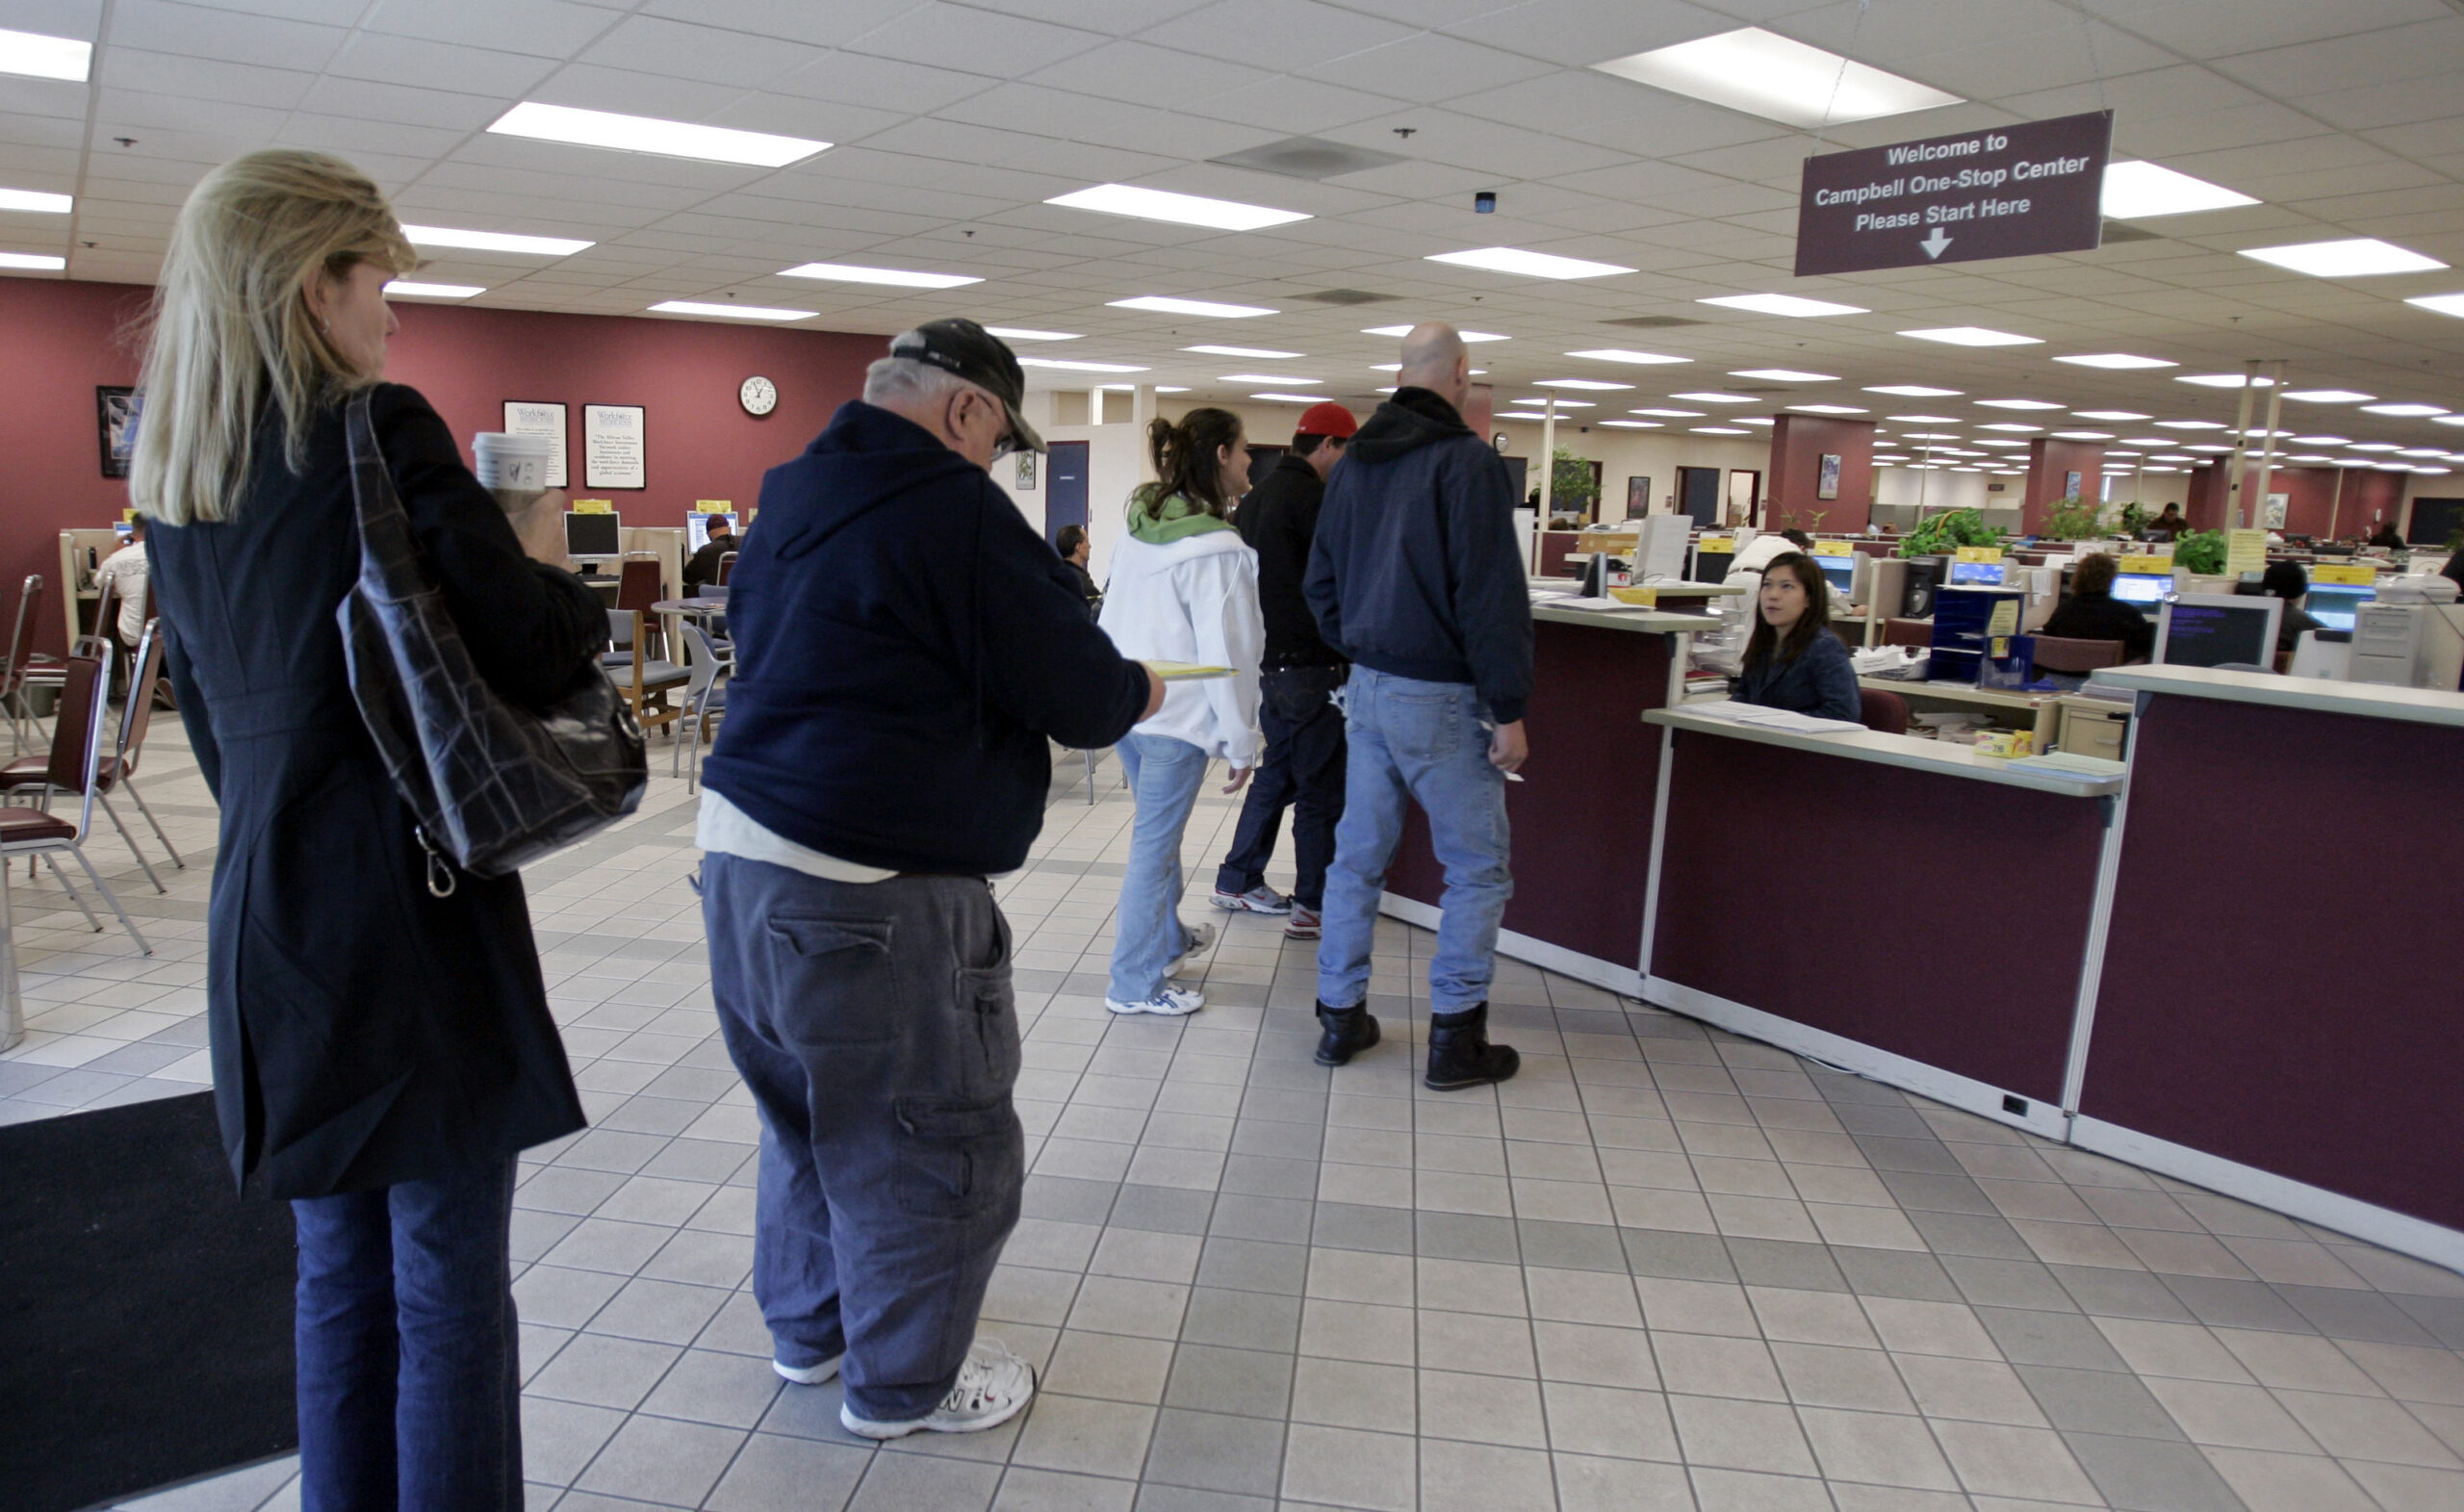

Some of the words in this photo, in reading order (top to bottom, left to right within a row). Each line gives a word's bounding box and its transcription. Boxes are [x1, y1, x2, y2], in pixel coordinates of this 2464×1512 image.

[1887, 141, 1981, 167] Welcome
[1985, 134, 2009, 153] to
[1815, 178, 1905, 207] Campbell
[1910, 167, 2008, 195] One-Stop
[2013, 155, 2091, 182] Center
[1855, 210, 1920, 232] Please
[1925, 203, 1976, 225] Start
[1980, 196, 2031, 218] Here
